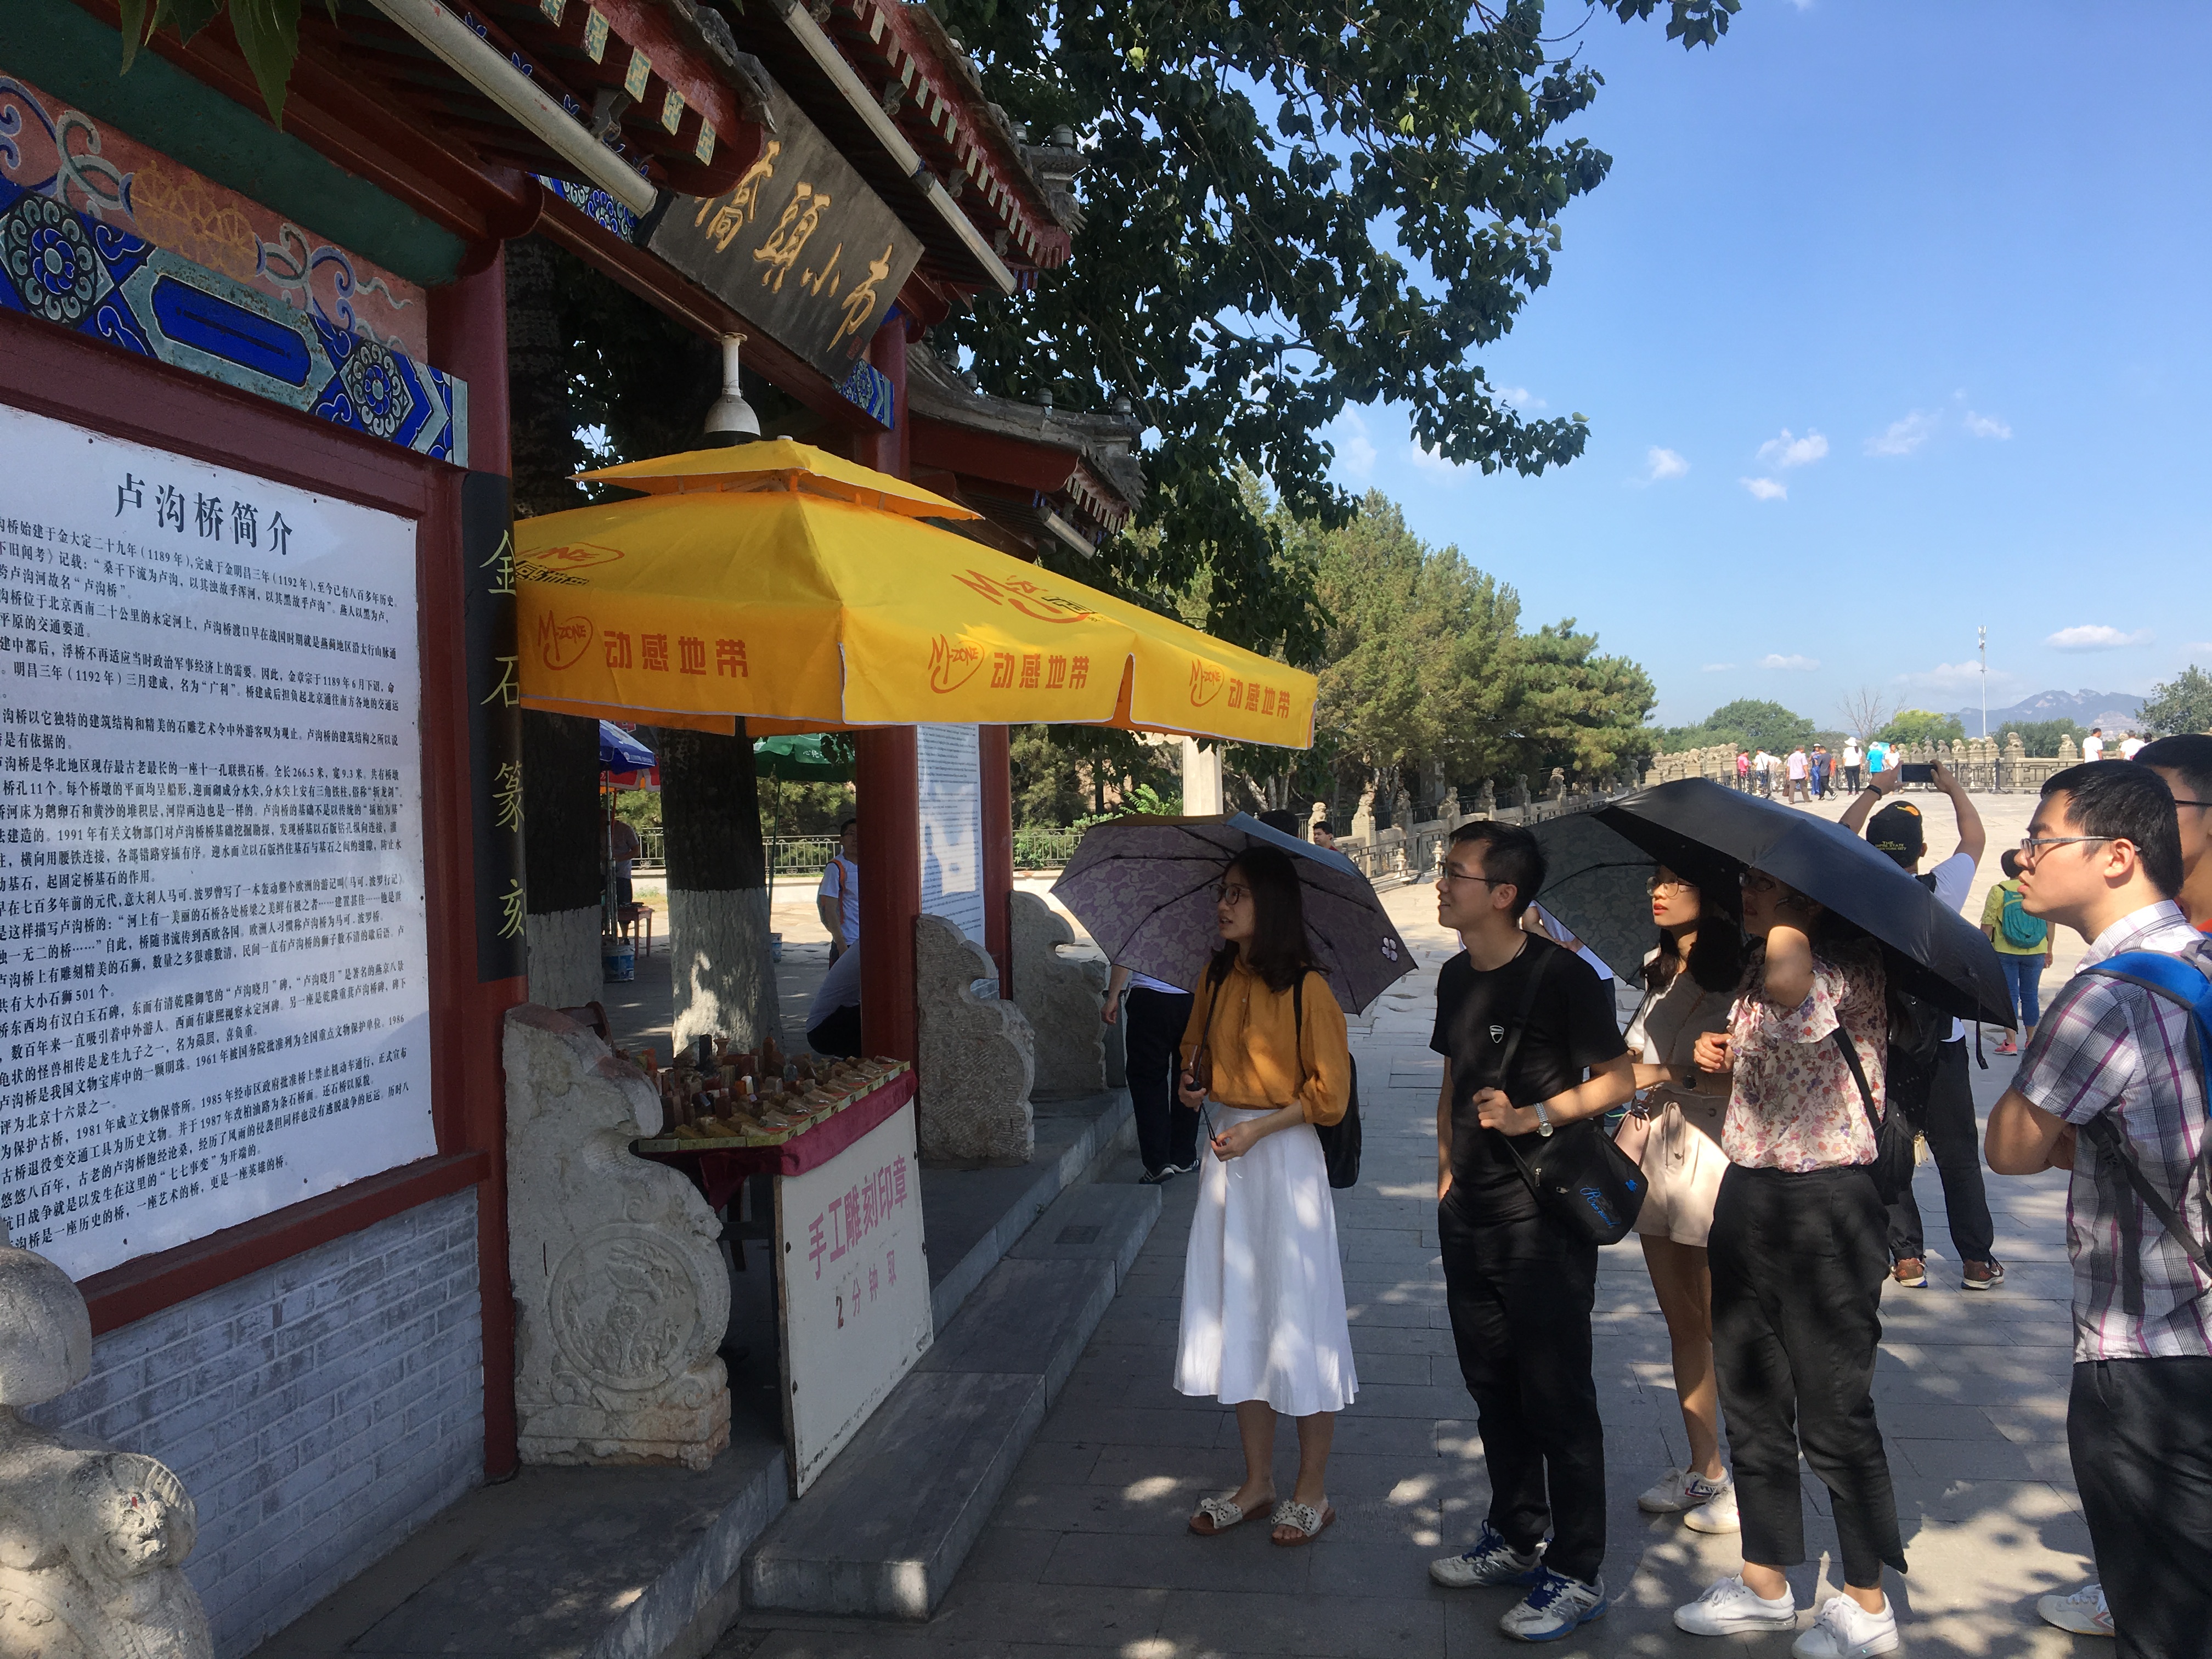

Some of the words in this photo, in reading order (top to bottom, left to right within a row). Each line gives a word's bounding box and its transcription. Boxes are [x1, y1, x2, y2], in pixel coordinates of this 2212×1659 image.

[115, 472, 293, 555] 卢沟桥简介
[604, 630, 748, 678] 动感地带
[990, 652, 1089, 690] 动感地带
[1228, 678, 1290, 719] 动感地带
[0, 731, 72, 749] 是有依据的。
[809, 1154, 908, 1281] 手工雕刻印章
